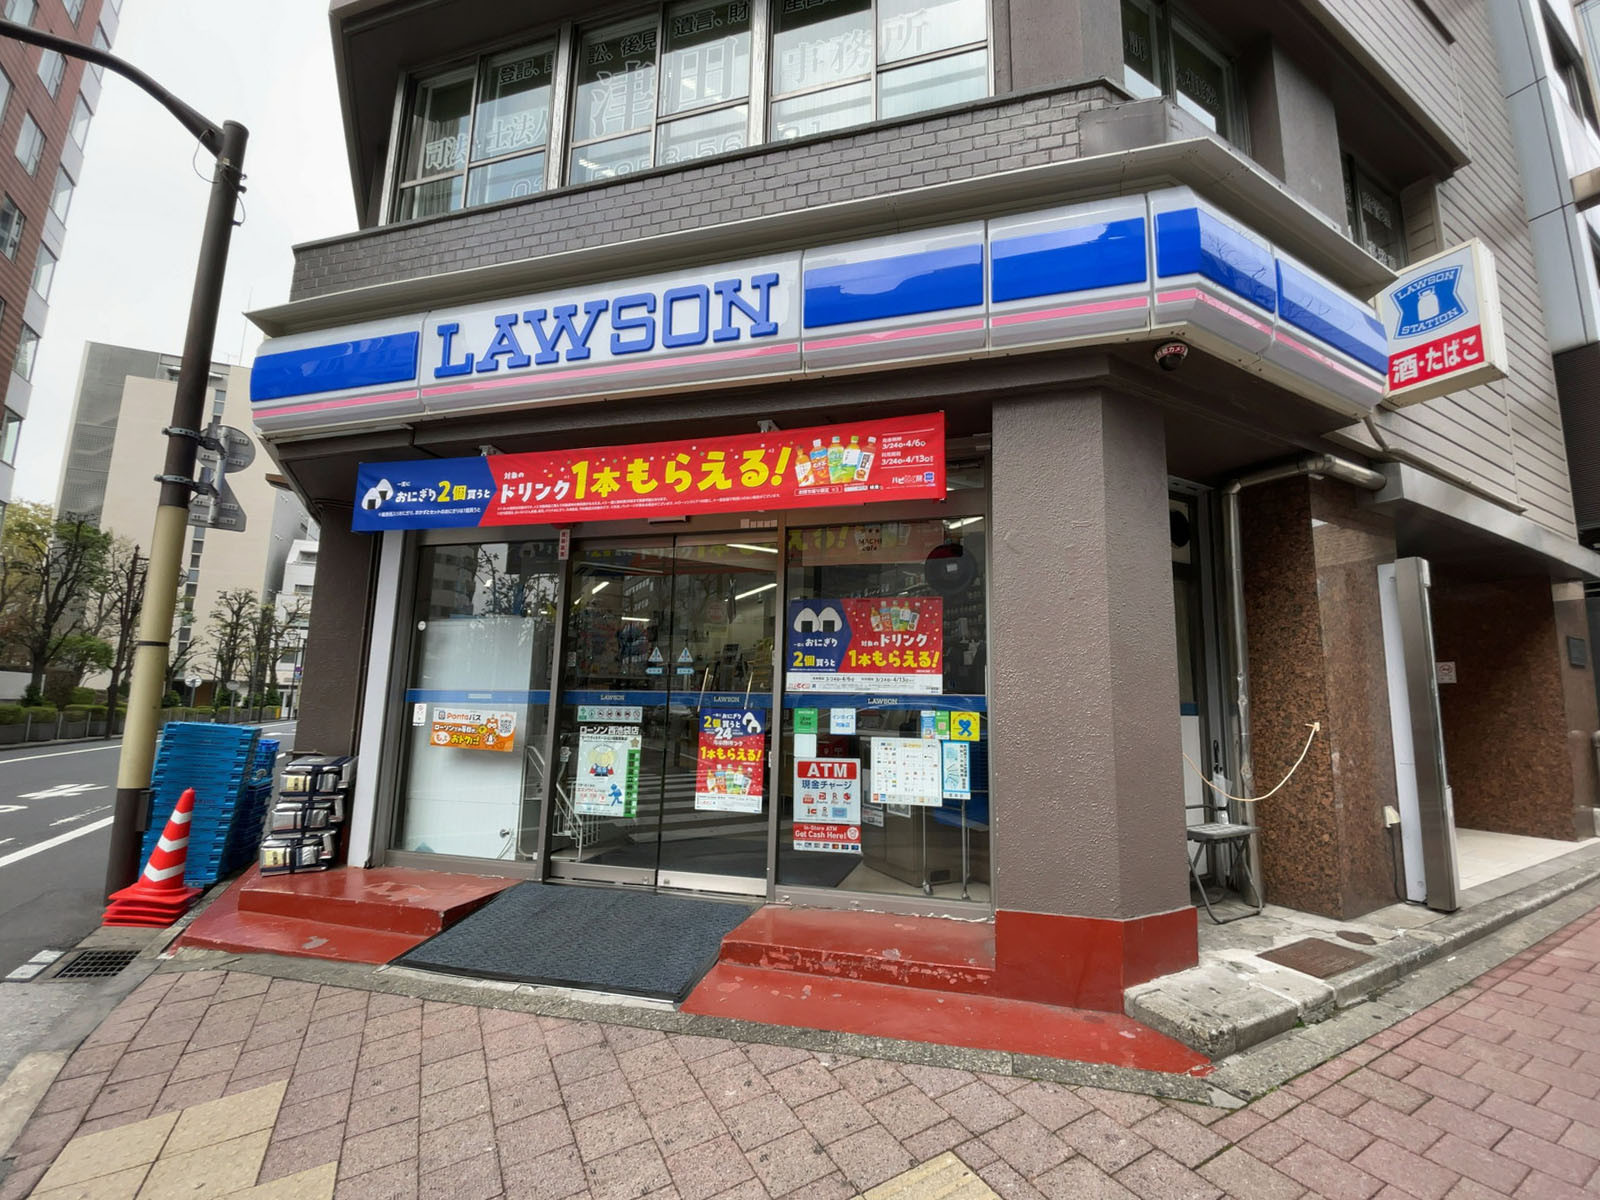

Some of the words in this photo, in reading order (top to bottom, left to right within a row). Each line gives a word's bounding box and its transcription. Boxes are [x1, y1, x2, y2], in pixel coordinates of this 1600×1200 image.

[1395, 269, 1456, 299] LAWSON
[434, 272, 780, 379] LAWSON
[1401, 307, 1460, 336] STATION
[1391, 335, 1480, 384] 酒・たばこ
[500, 480, 571, 504] ドリンク
[805, 637, 838, 648] おにぎり
[880, 633, 928, 648] ドリンク
[714, 727, 732, 740] 24
[806, 762, 848, 778] ATM
[801, 779, 853, 790] 現金チャージ
[795, 830, 807, 838] Get
[808, 830, 825, 838] Cash
